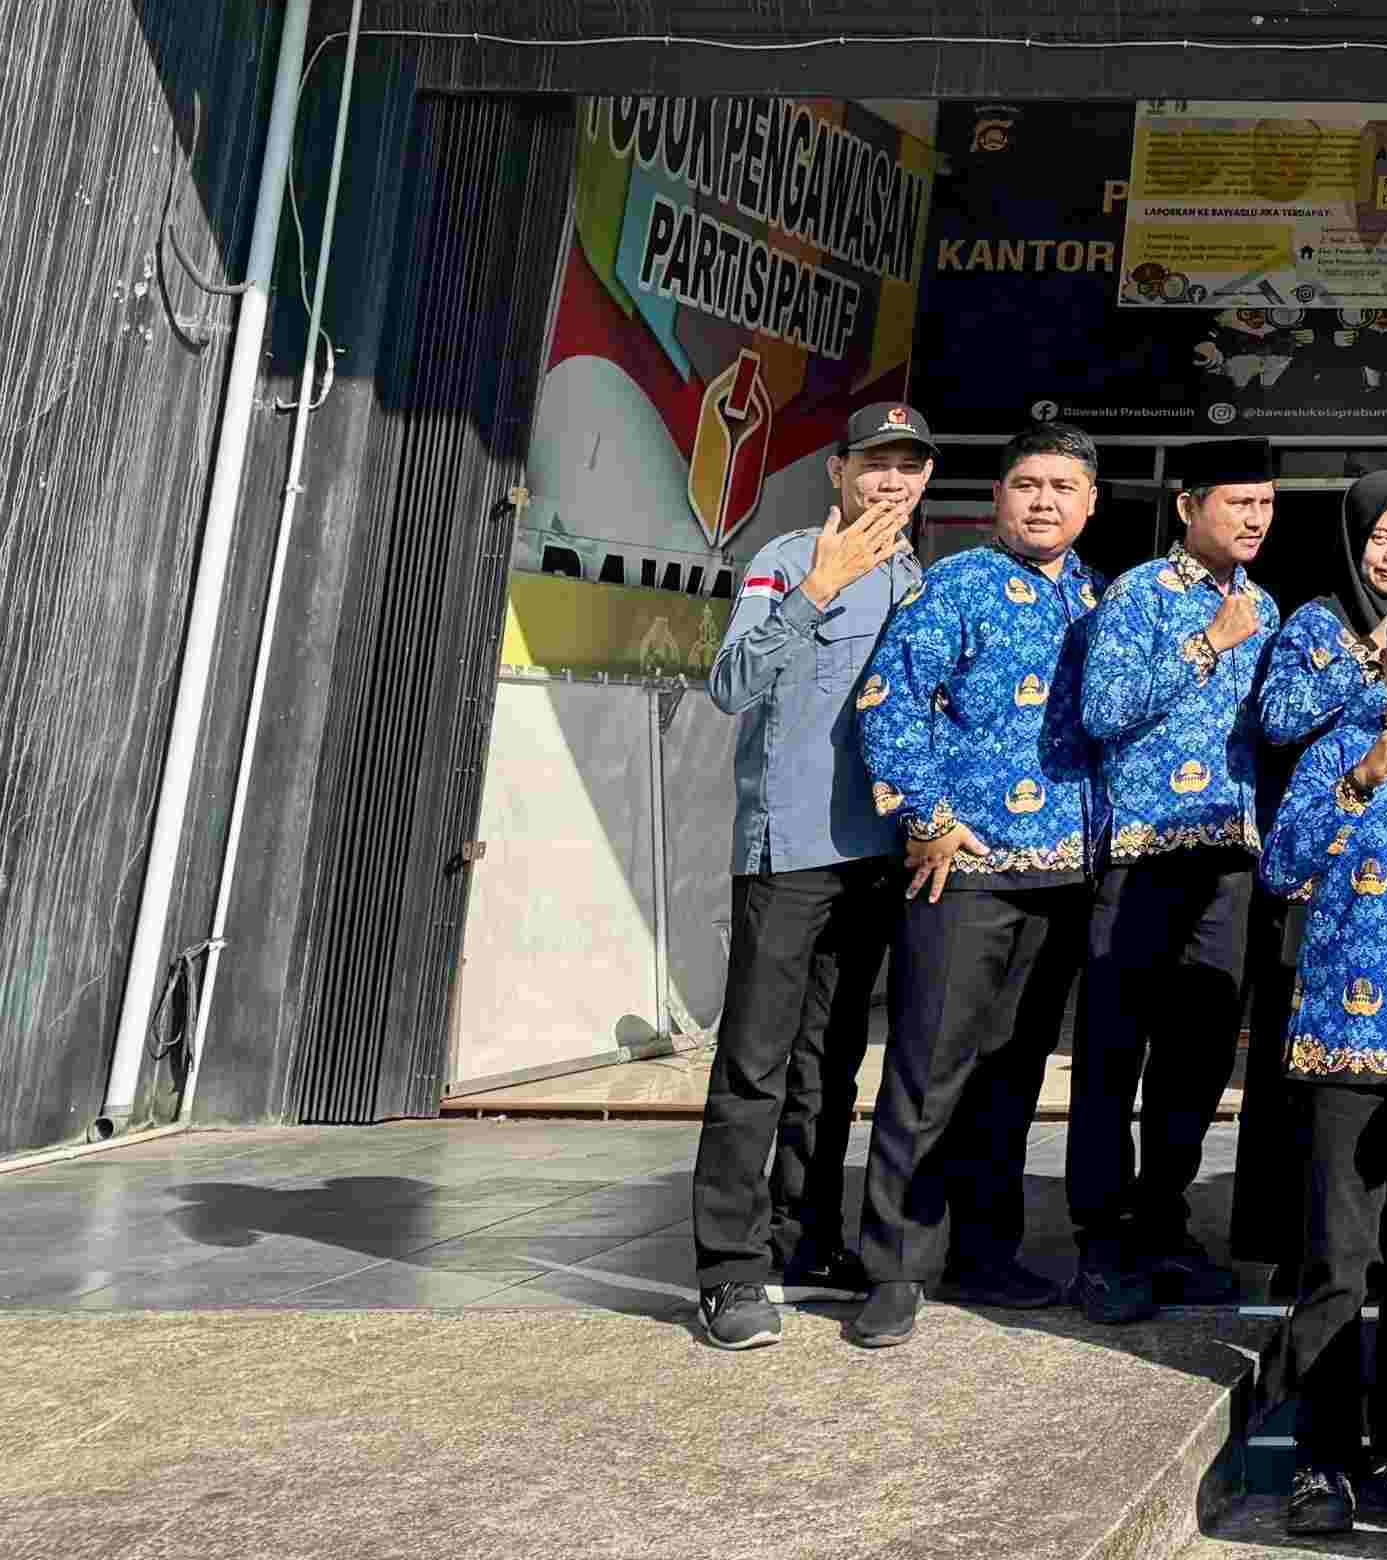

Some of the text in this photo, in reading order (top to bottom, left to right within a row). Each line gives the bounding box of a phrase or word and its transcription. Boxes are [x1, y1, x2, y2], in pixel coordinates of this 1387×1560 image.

[717, 96, 928, 282] PENGAWASAN
[937, 238, 1115, 274] KANTOR
[638, 192, 860, 359] PARTISIPATIF
